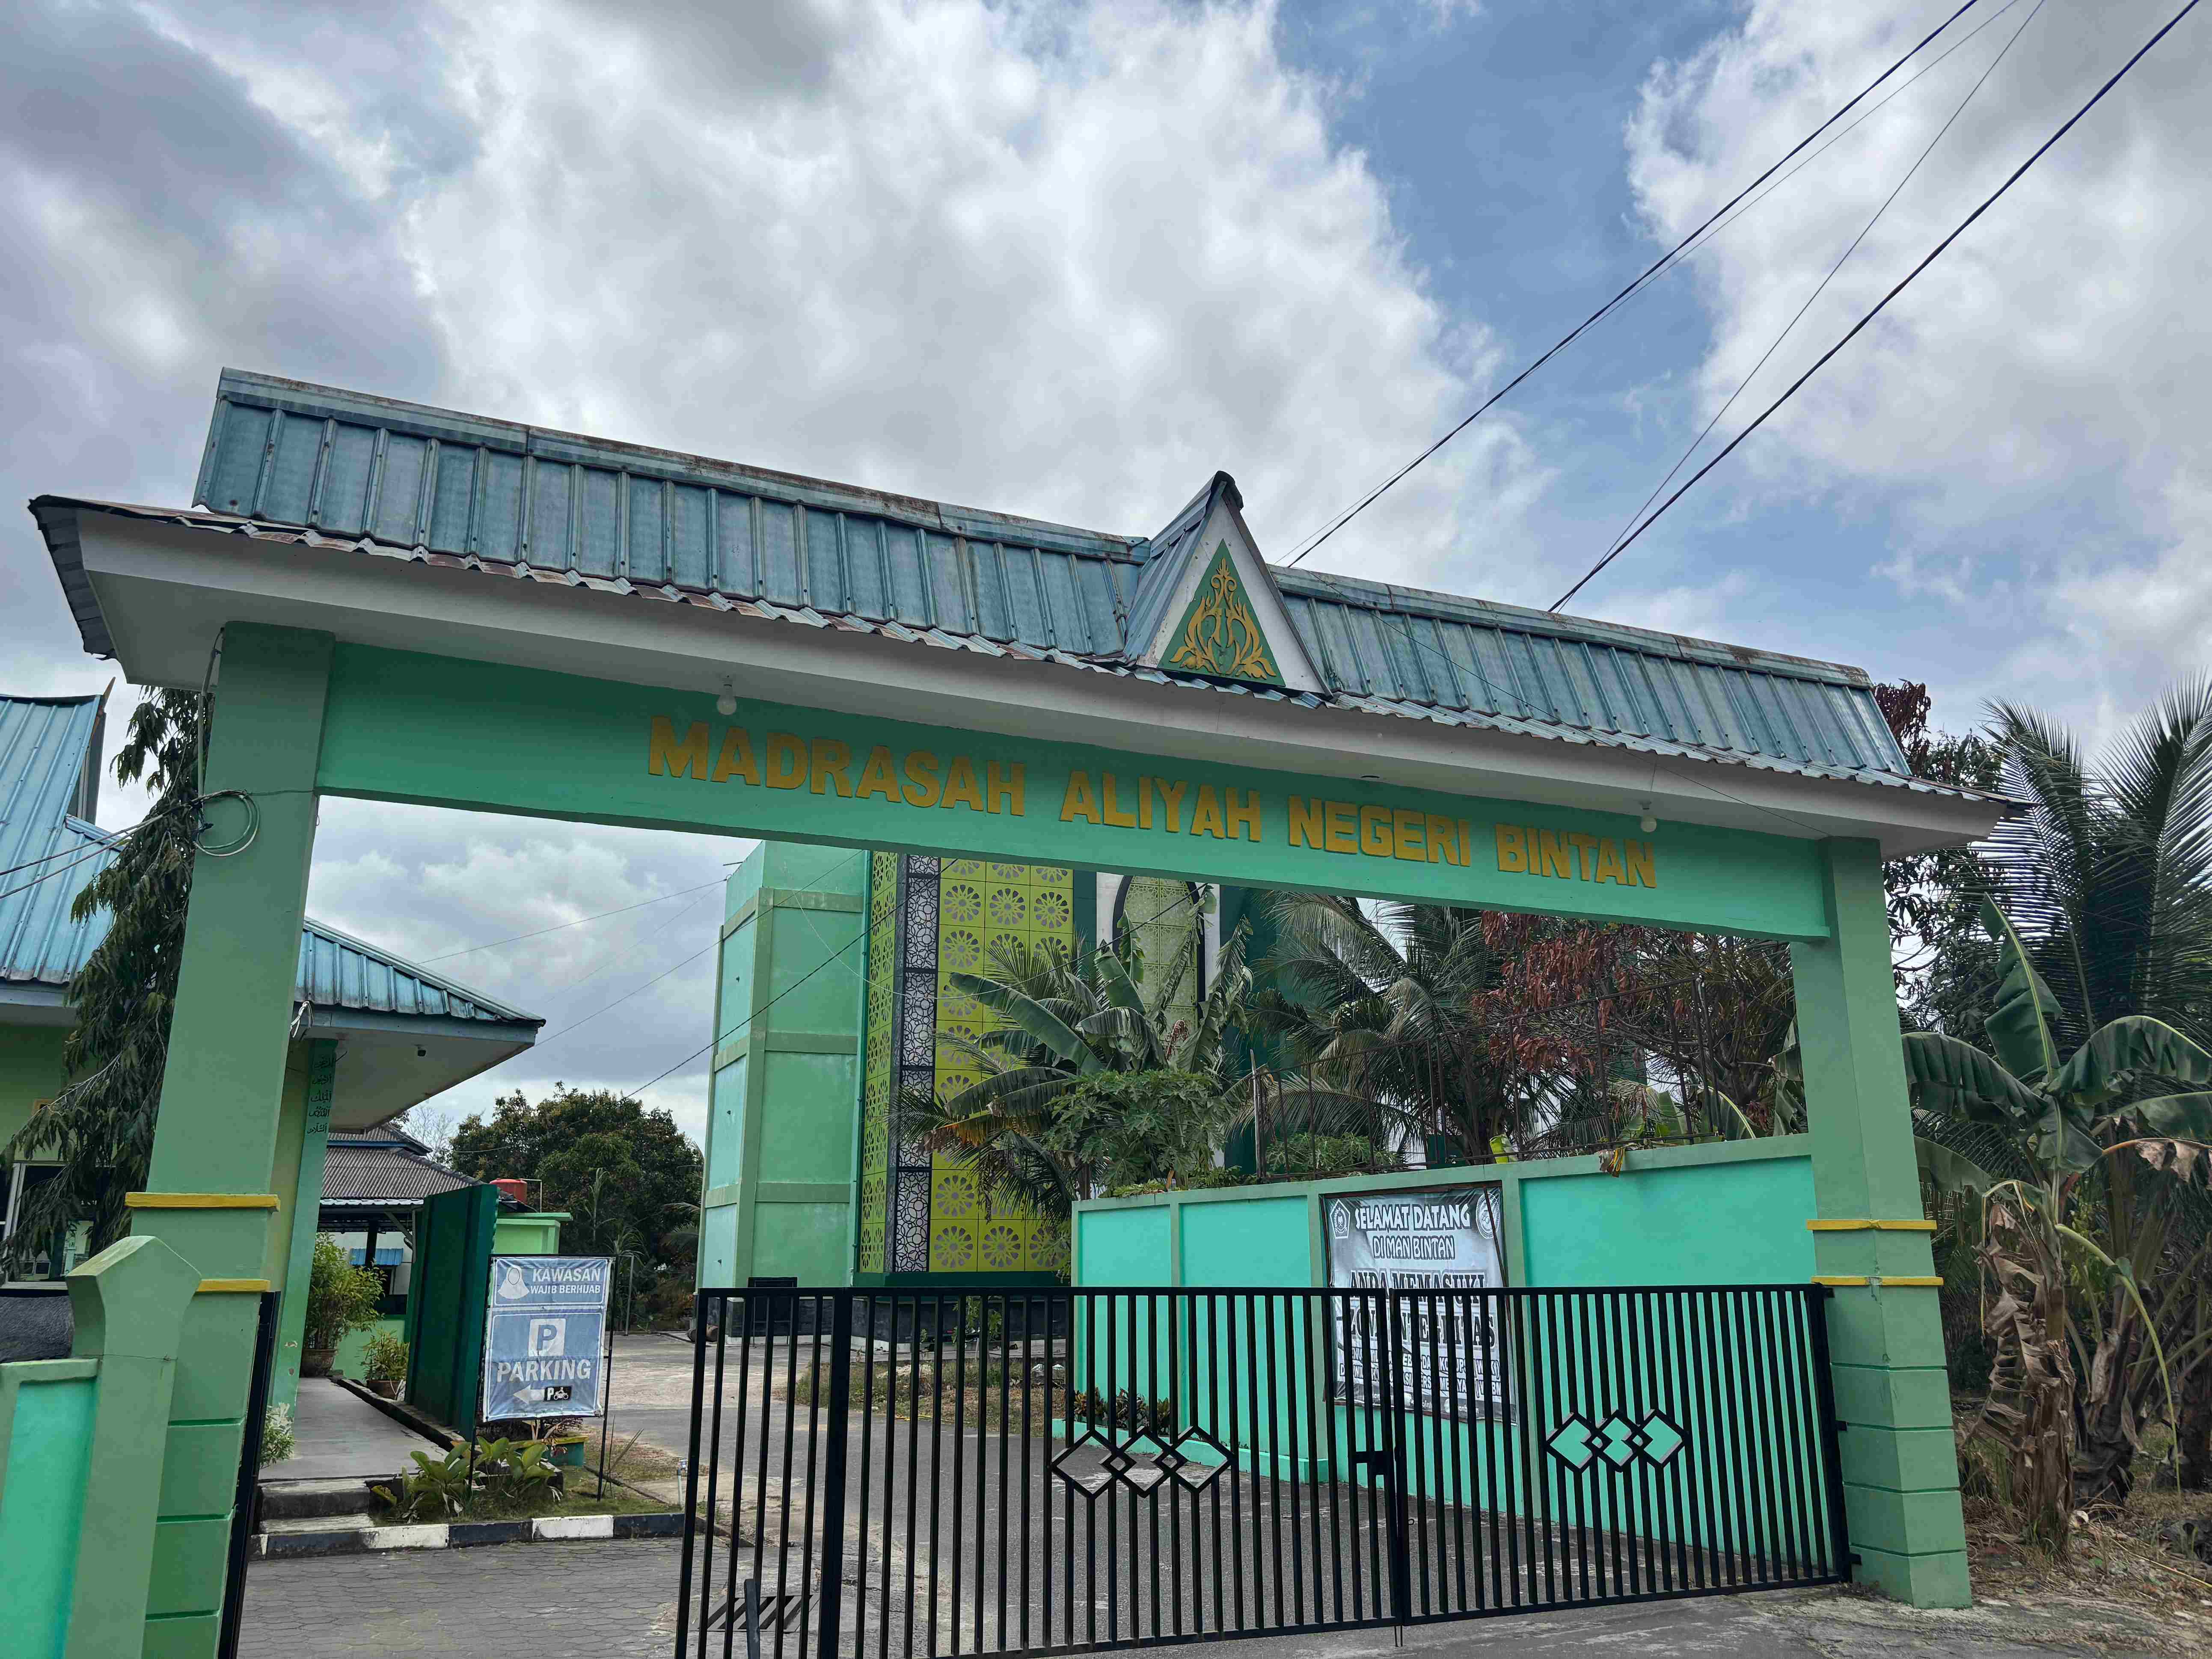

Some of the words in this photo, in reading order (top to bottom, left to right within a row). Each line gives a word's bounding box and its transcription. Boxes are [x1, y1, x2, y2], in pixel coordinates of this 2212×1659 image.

[648, 715, 1025, 817] MADRASAH
[1059, 770, 1260, 843] ALIYAH
[1288, 795, 1470, 867] NEGERI
[1496, 823, 1657, 888] BINTAN
[1355, 1205, 1410, 1230] SELAMAT
[1413, 1204, 1471, 1230] DATANG
[1373, 1236, 1385, 1258] DI
[1386, 1235, 1411, 1259] MAN
[1413, 1235, 1455, 1260] BINTAN
[532, 1268, 601, 1282] KAWASAN
[530, 1285, 557, 1294] WAJIB
[559, 1285, 601, 1294] BERHIJAB
[537, 1324, 557, 1351] P
[496, 1359, 591, 1383] PARKING
[547, 1387, 554, 1401] P
